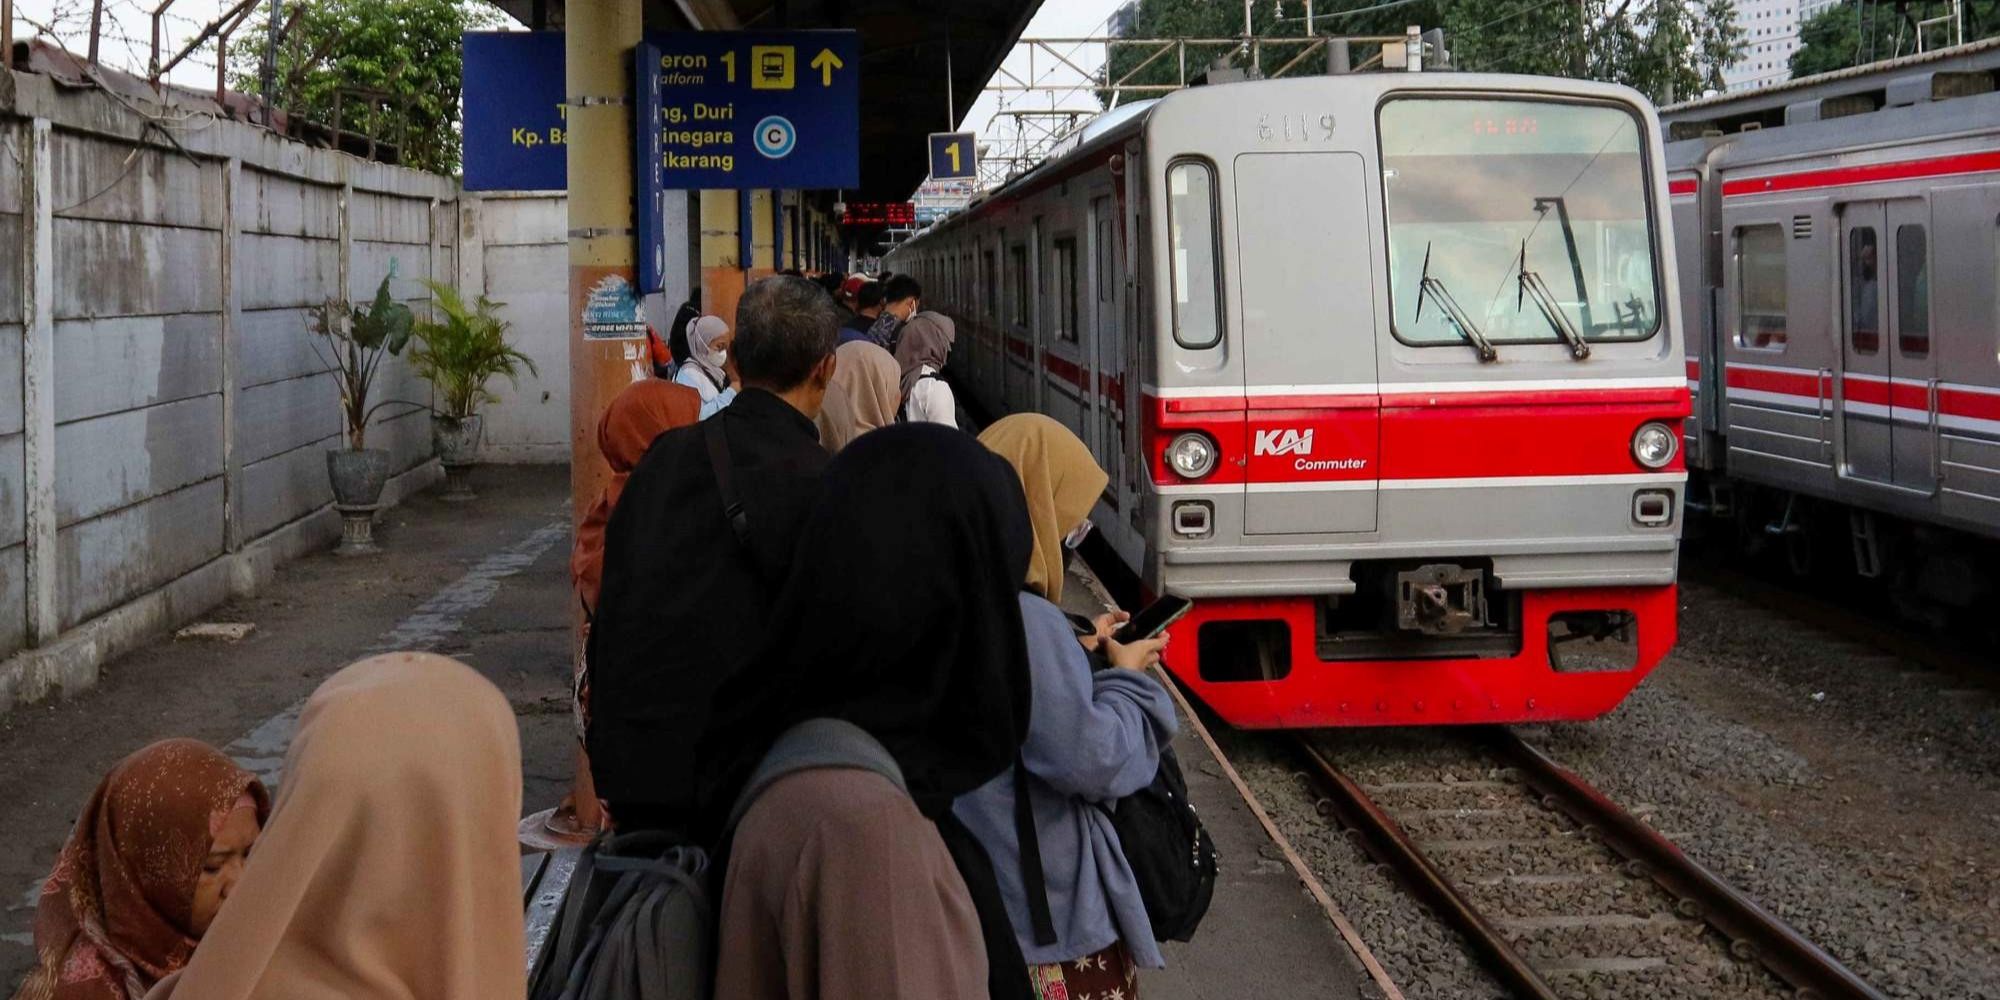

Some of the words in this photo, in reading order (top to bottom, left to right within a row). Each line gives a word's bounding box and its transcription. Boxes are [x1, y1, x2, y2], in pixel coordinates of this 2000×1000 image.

[660, 54, 707, 67] eron
[720, 51, 735, 82] 1
[660, 72, 704, 85] atform
[662, 105, 688, 123] ng,
[694, 103, 733, 119] Duri
[662, 128, 734, 147] inegara
[768, 129, 782, 144] C
[1257, 113, 1336, 142] 6119
[512, 128, 544, 148] Kp.
[652, 73, 661, 213] KARET
[662, 151, 734, 171] ikarang
[945, 142, 960, 172] 1
[1254, 428, 1313, 455] KAI
[1294, 458, 1367, 471] Commuter
